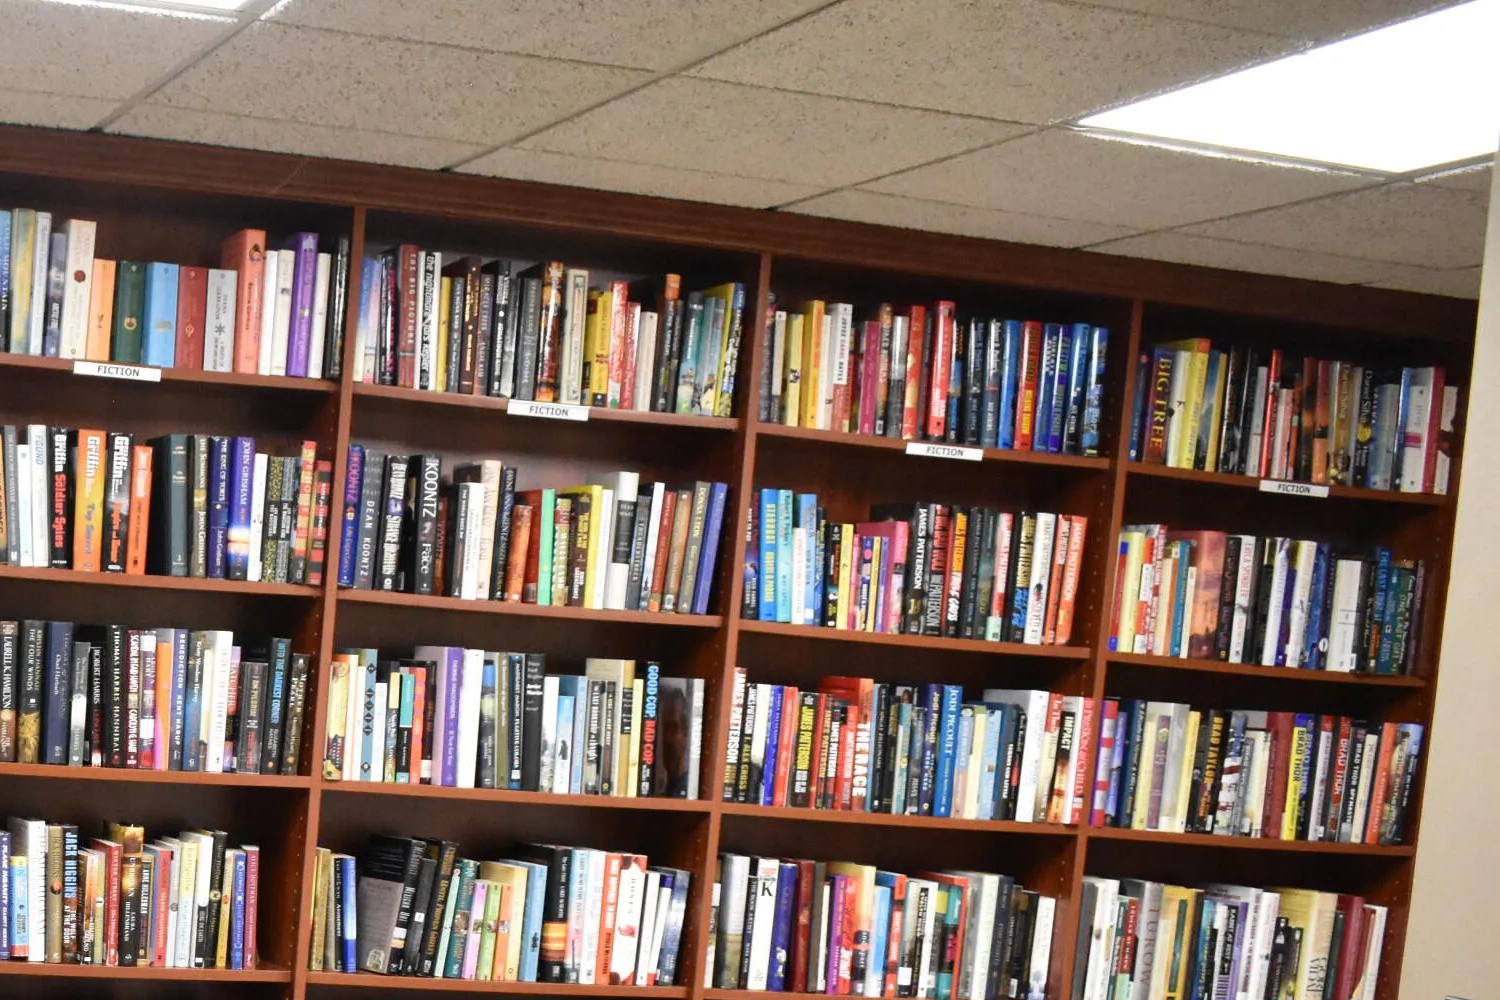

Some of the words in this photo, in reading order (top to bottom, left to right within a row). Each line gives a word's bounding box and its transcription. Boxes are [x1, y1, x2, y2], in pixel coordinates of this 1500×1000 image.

[408, 277, 416, 298] BIG
[407, 302, 415, 345] PICTURE
[97, 366, 140, 377] FICTION
[1156, 357, 1174, 391] BIG
[529, 405, 569, 417] FICTION
[1150, 400, 1168, 448] TREE
[54, 434, 66, 472] Griffin
[926, 446, 965, 457] FICTION
[52, 473, 66, 514] Soldier
[422, 462, 438, 517] KOONTZ
[1277, 484, 1311, 494] FICTION
[365, 501, 374, 528] DEAN
[915, 508, 928, 539] JAMES
[53, 517, 65, 548] Spies
[360, 537, 370, 576] KOONTZ
[420, 543, 432, 574] Face
[913, 541, 926, 590] PATTERSON
[113, 631, 121, 666] THOMAS
[176, 633, 186, 689] BENEDICTION
[112, 668, 121, 701] HARRIS
[646, 665, 659, 693] GOOD
[175, 695, 183, 713] KENT
[947, 688, 960, 711] JODI
[112, 706, 120, 753] HANNIBAL
[174, 715, 182, 746] HARUF
[644, 719, 656, 742] BAD
[801, 706, 816, 731] JAMES
[944, 712, 958, 755] PICOULT
[1060, 716, 1074, 750] IMPACT
[1210, 717, 1224, 744] BRAD
[642, 744, 654, 764] COP
[796, 731, 812, 770] PATTERSON
[855, 722, 871, 754] THE
[852, 756, 869, 797] RACE
[1204, 746, 1220, 784] TAYLOR
[64, 832, 78, 857] JACK
[63, 860, 77, 898] HIGGINS
